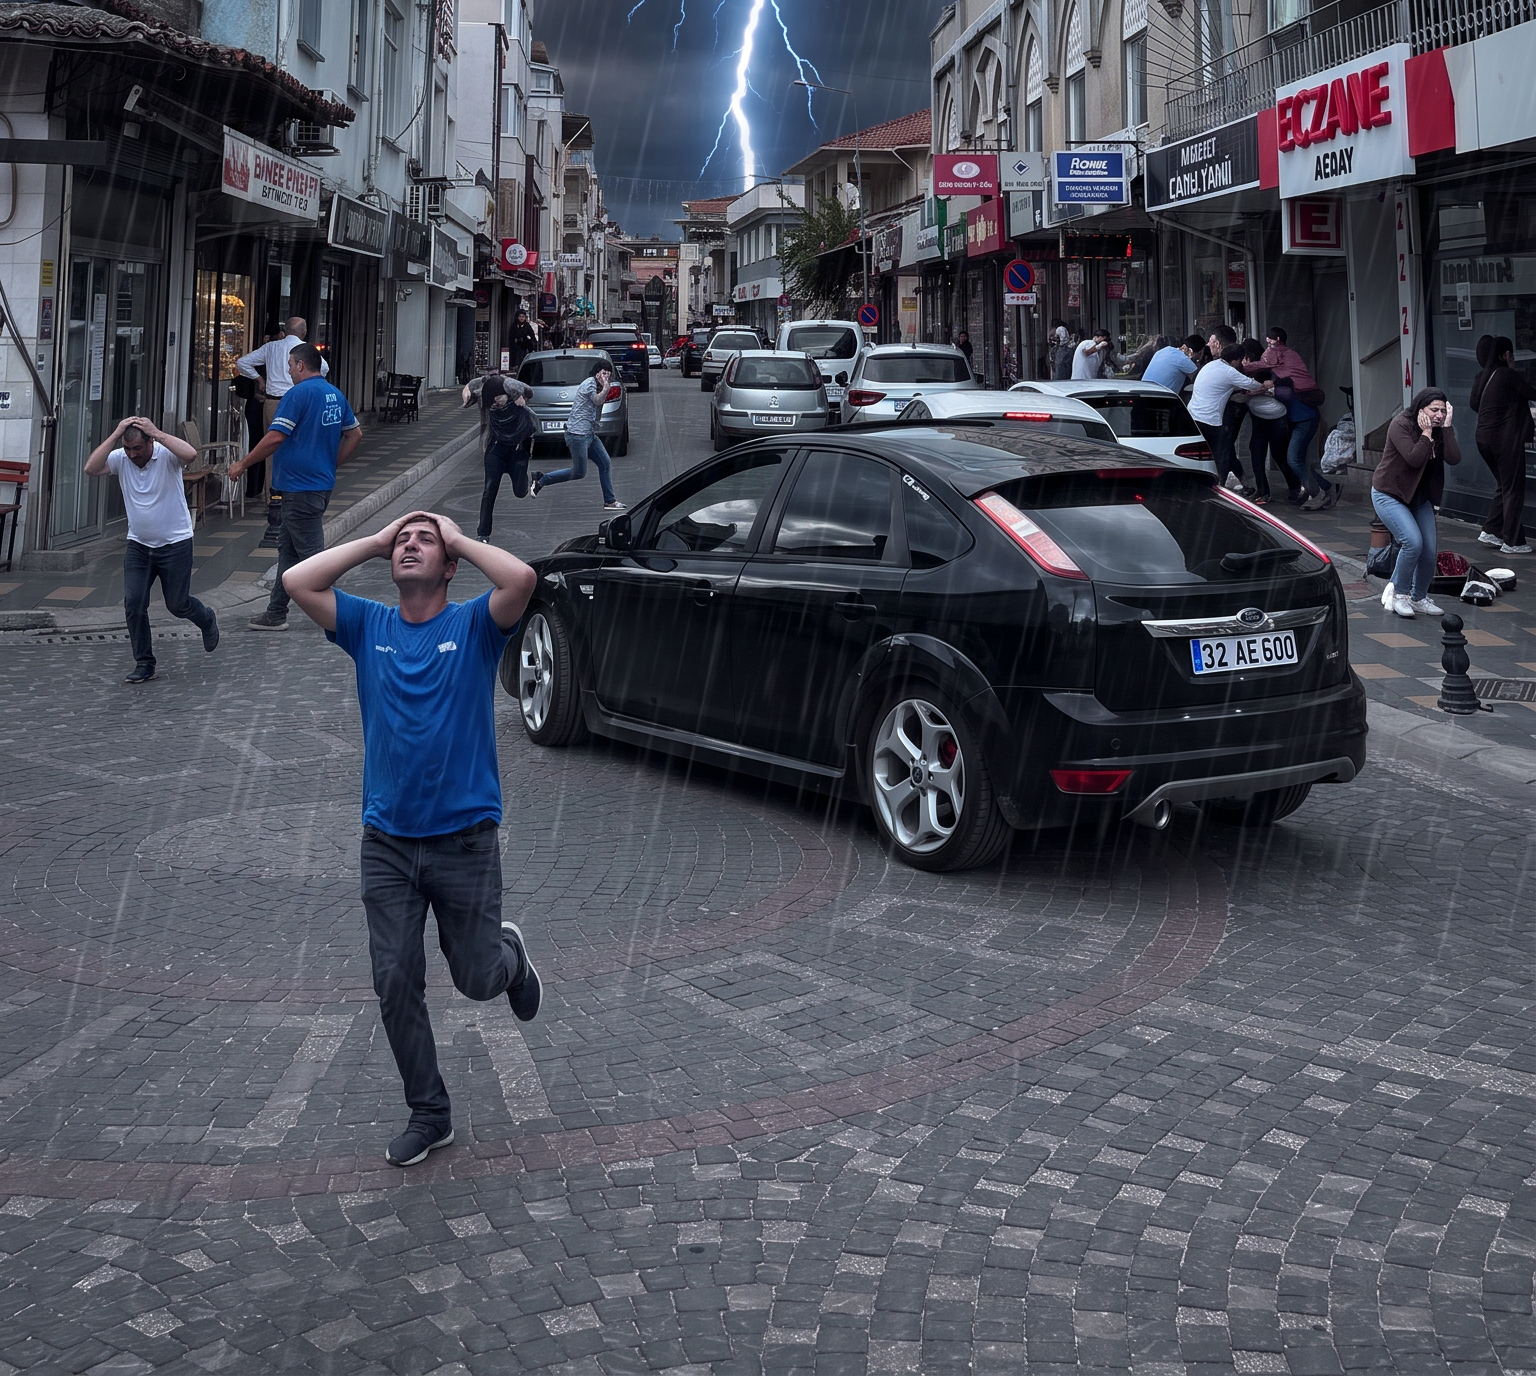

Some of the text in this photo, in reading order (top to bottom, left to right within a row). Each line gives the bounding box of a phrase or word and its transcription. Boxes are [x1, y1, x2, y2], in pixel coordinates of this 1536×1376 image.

[1277, 61, 1392, 153] ECZANE
[1300, 204, 1331, 241] E
[1201, 635, 1295, 668] 32 AE 600
